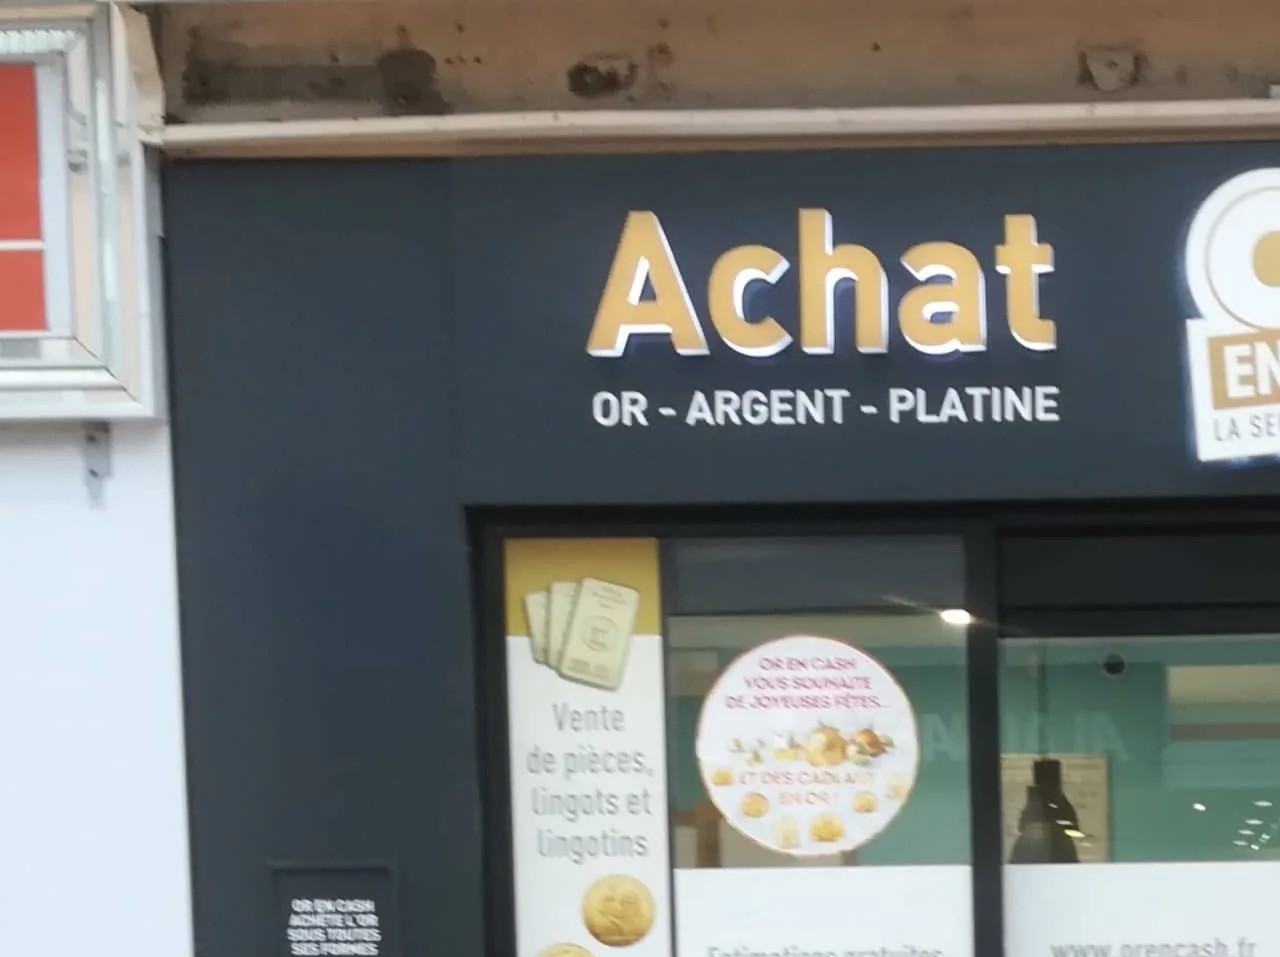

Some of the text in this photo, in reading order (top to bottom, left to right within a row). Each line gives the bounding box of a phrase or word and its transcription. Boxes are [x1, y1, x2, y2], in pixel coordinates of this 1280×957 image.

[586, 207, 1057, 358] Achat
[592, 390, 649, 427] OR
[686, 388, 850, 427] ARGENT
[889, 385, 1061, 424] PLATINE
[1213, 416, 1240, 442] LA
[552, 702, 626, 733] Vente
[525, 744, 655, 780] de pièces,
[531, 787, 653, 823] lingots et
[536, 828, 650, 866] lingotins
